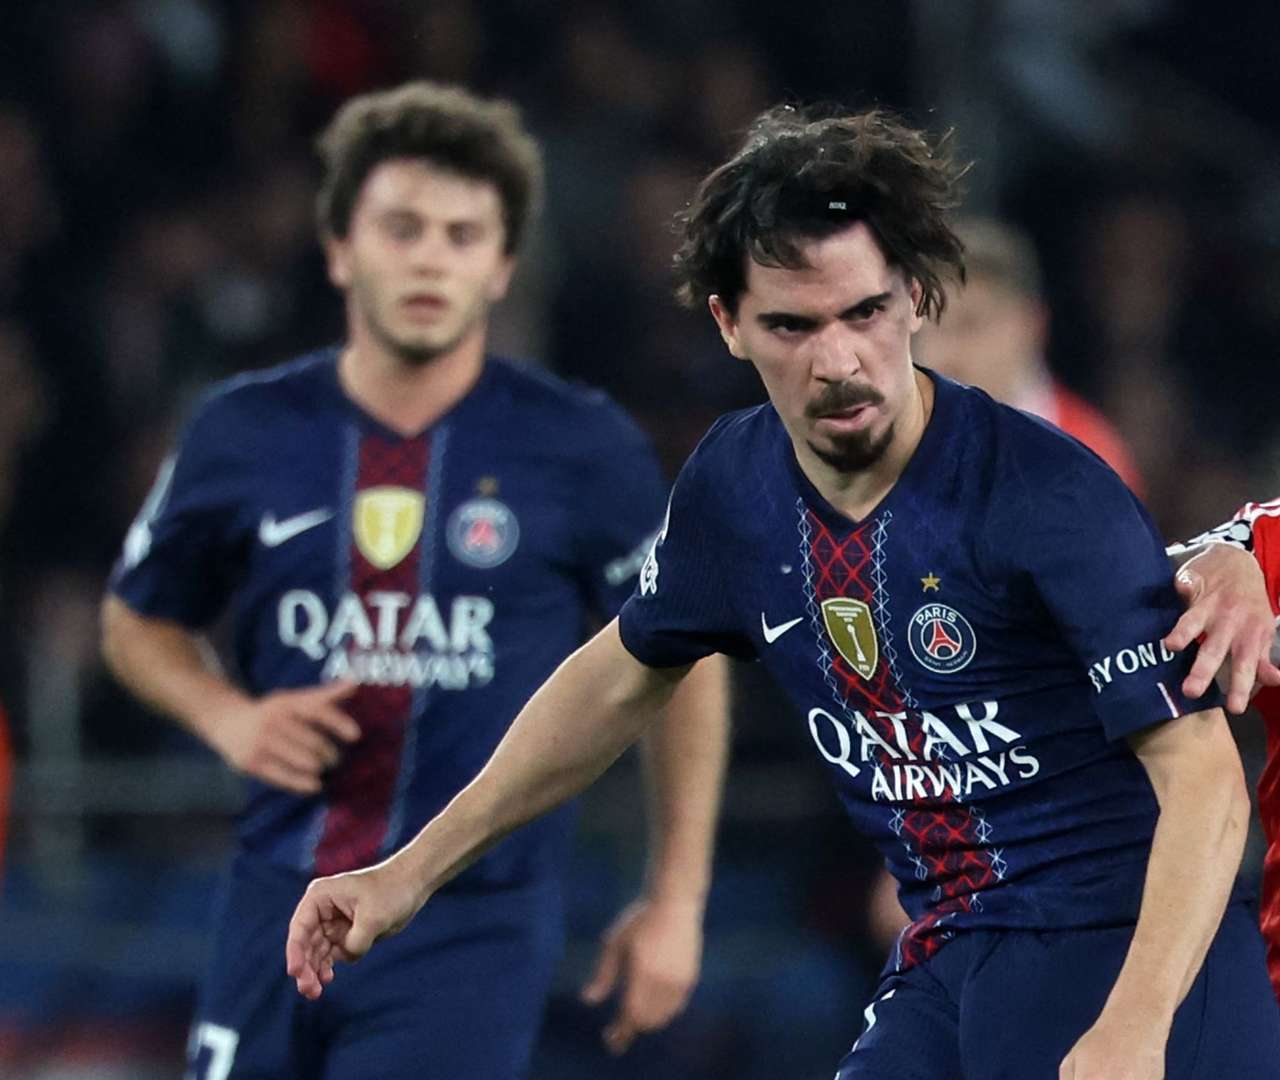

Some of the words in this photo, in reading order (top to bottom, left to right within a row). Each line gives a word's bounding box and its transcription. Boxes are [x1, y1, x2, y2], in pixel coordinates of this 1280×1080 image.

[277, 588, 495, 660] QATAR
[916, 607, 958, 626] PARIS
[808, 701, 1022, 778] QATAR
[871, 746, 1040, 801] AIRWAYS
